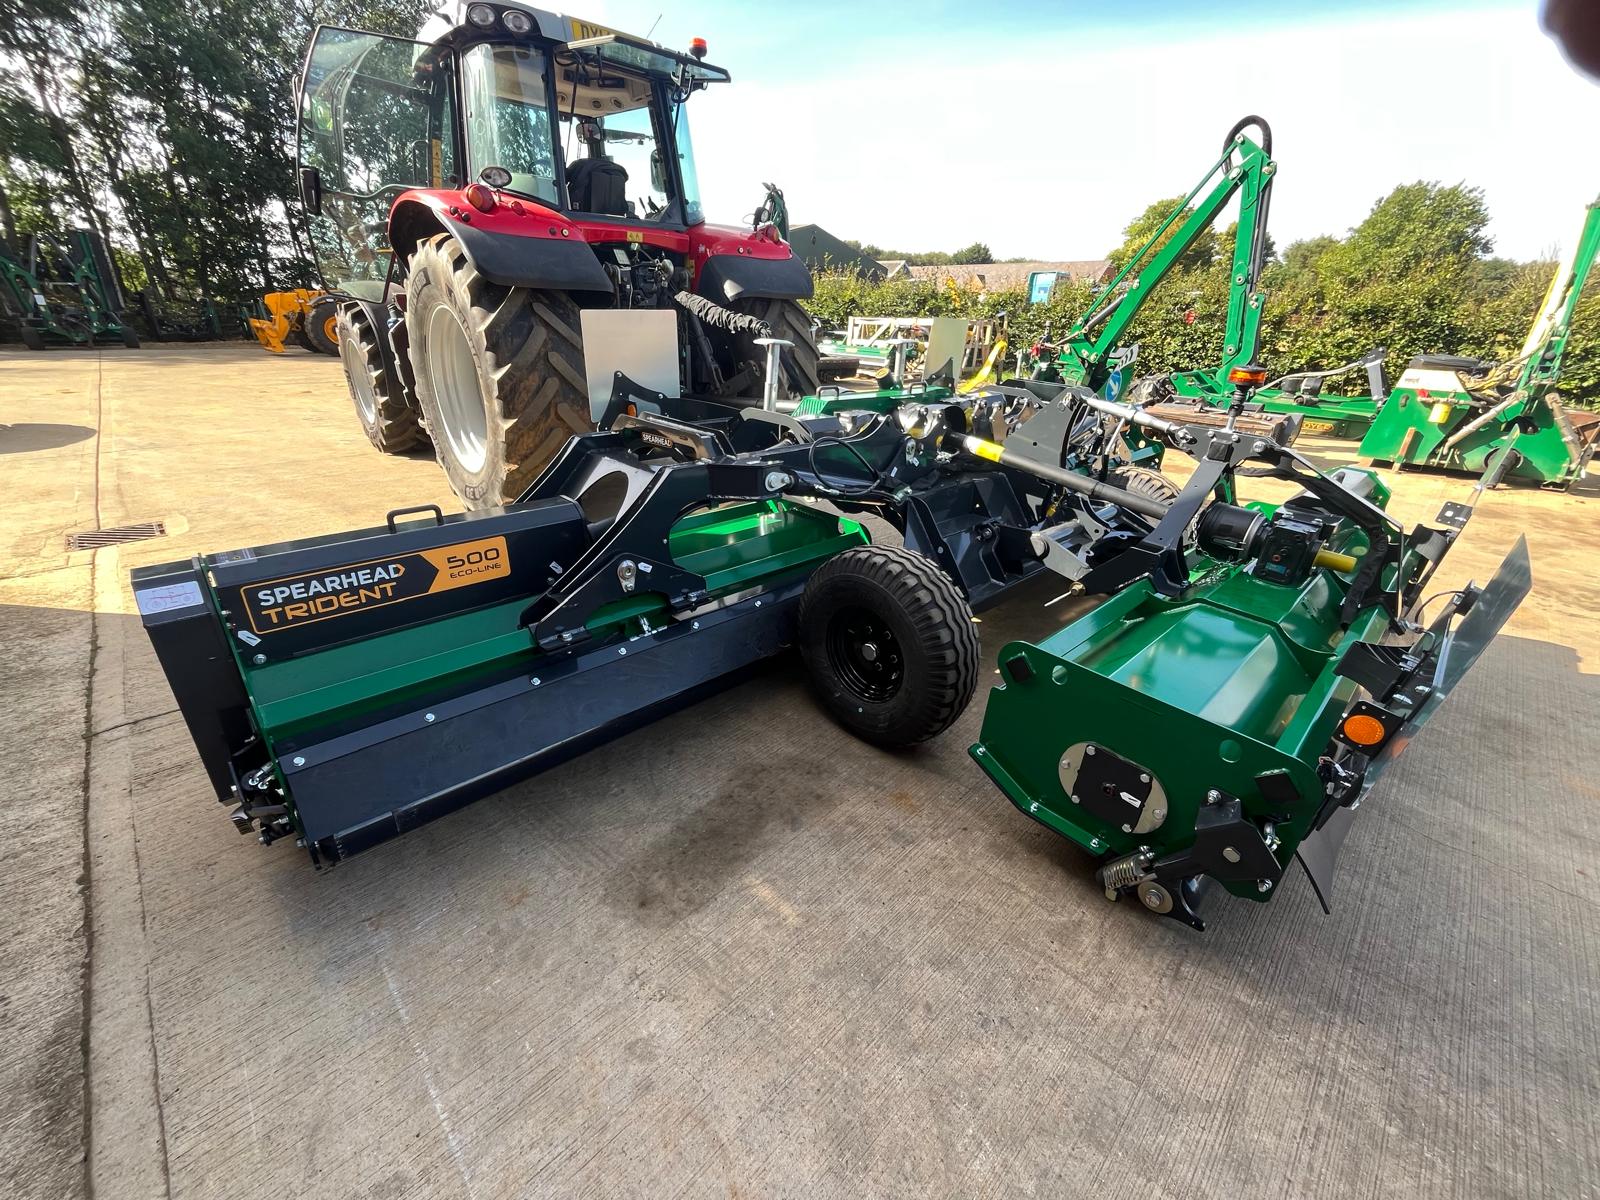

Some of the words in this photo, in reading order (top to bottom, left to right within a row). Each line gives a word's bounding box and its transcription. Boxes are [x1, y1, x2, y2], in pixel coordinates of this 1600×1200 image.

[446, 547, 500, 570] 500
[449, 562, 502, 579] ECO-LINE
[257, 563, 406, 607] SPEARHEAD
[261, 581, 397, 624] TRIDENT
